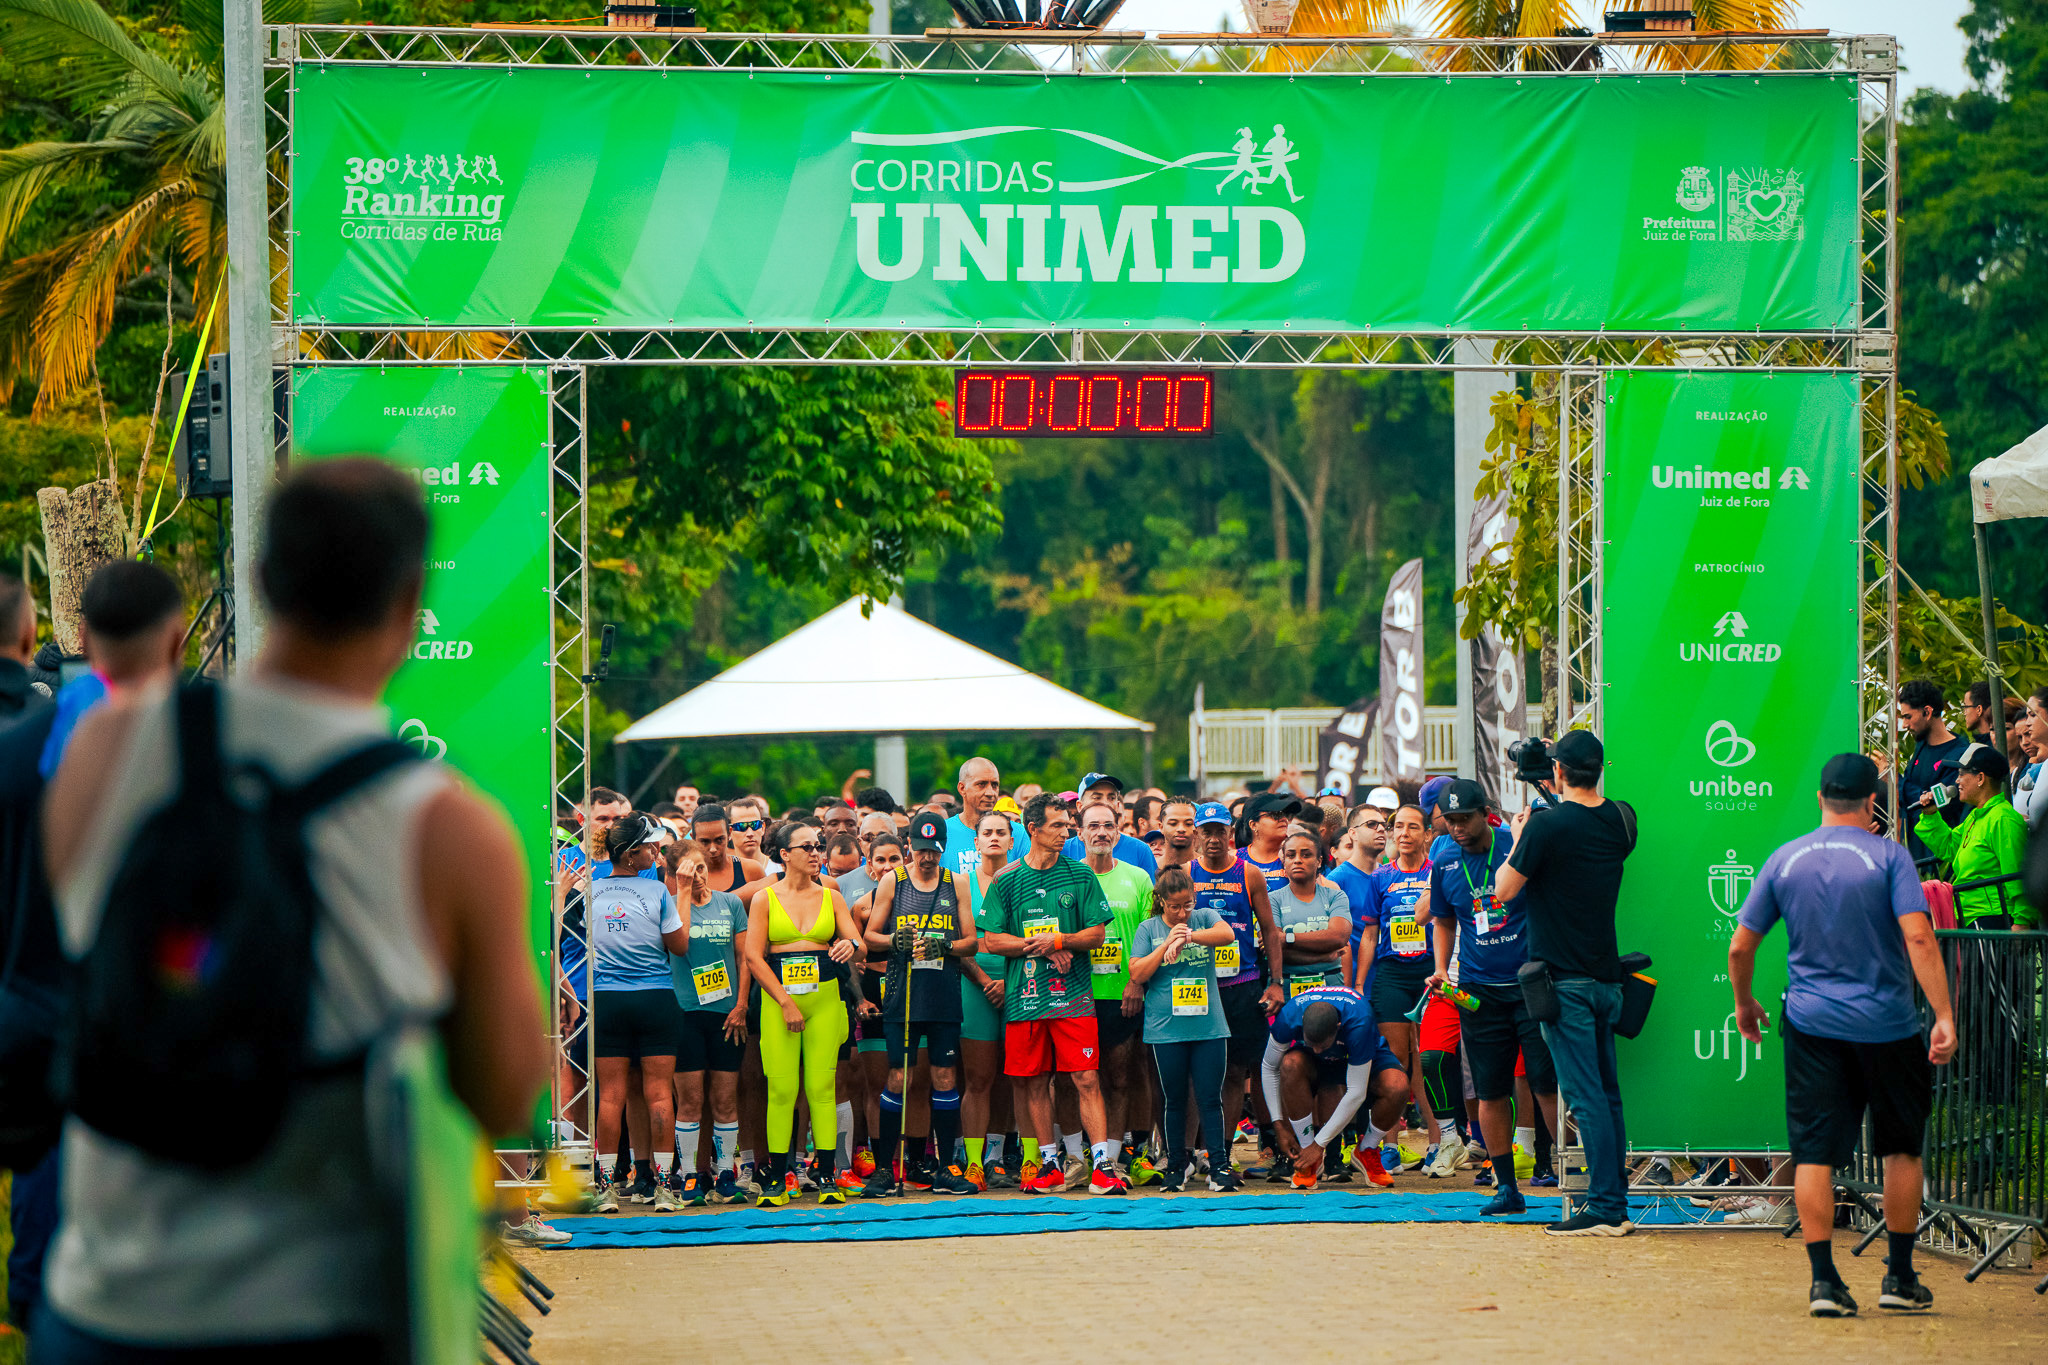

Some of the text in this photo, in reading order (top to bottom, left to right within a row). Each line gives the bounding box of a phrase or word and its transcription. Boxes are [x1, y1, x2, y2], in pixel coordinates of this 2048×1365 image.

[850, 159, 1054, 192] CORRIDAS
[342, 185, 505, 225] Ranking
[1642, 217, 1716, 229] Prefeitura
[340, 221, 503, 241] Corridas de Rua
[1642, 230, 1716, 241] Juiz de Fora
[850, 202, 1306, 283] UNIMED
[959, 374, 1211, 432] 00:00:00
[383, 404, 457, 418] REALIZAÇÃO
[1695, 410, 1768, 423] REALIZAÇÃO
[1651, 465, 1771, 490] Unimed
[433, 493, 461, 504] Fora
[1699, 496, 1771, 508] Juiz de Fora
[1694, 561, 1766, 574] PATROCÍNIO
[1679, 642, 1782, 663] UNICRED
[1392, 588, 1422, 776] TOR B
[1336, 712, 1369, 739] E
[1689, 774, 1773, 797] uniben
[1705, 799, 1758, 811] saúde
[607, 922, 630, 933] PJF
[896, 913, 955, 931] BRASIL
[688, 924, 731, 939] ORRE
[1395, 924, 1420, 936] GUIA
[1489, 937, 1500, 945] de
[1500, 933, 1518, 943] Fora
[1092, 946, 1118, 958] 1732
[1215, 949, 1235, 961] 760
[787, 965, 814, 978] 1751
[699, 970, 725, 988] 1705
[1178, 987, 1203, 999] 1741
